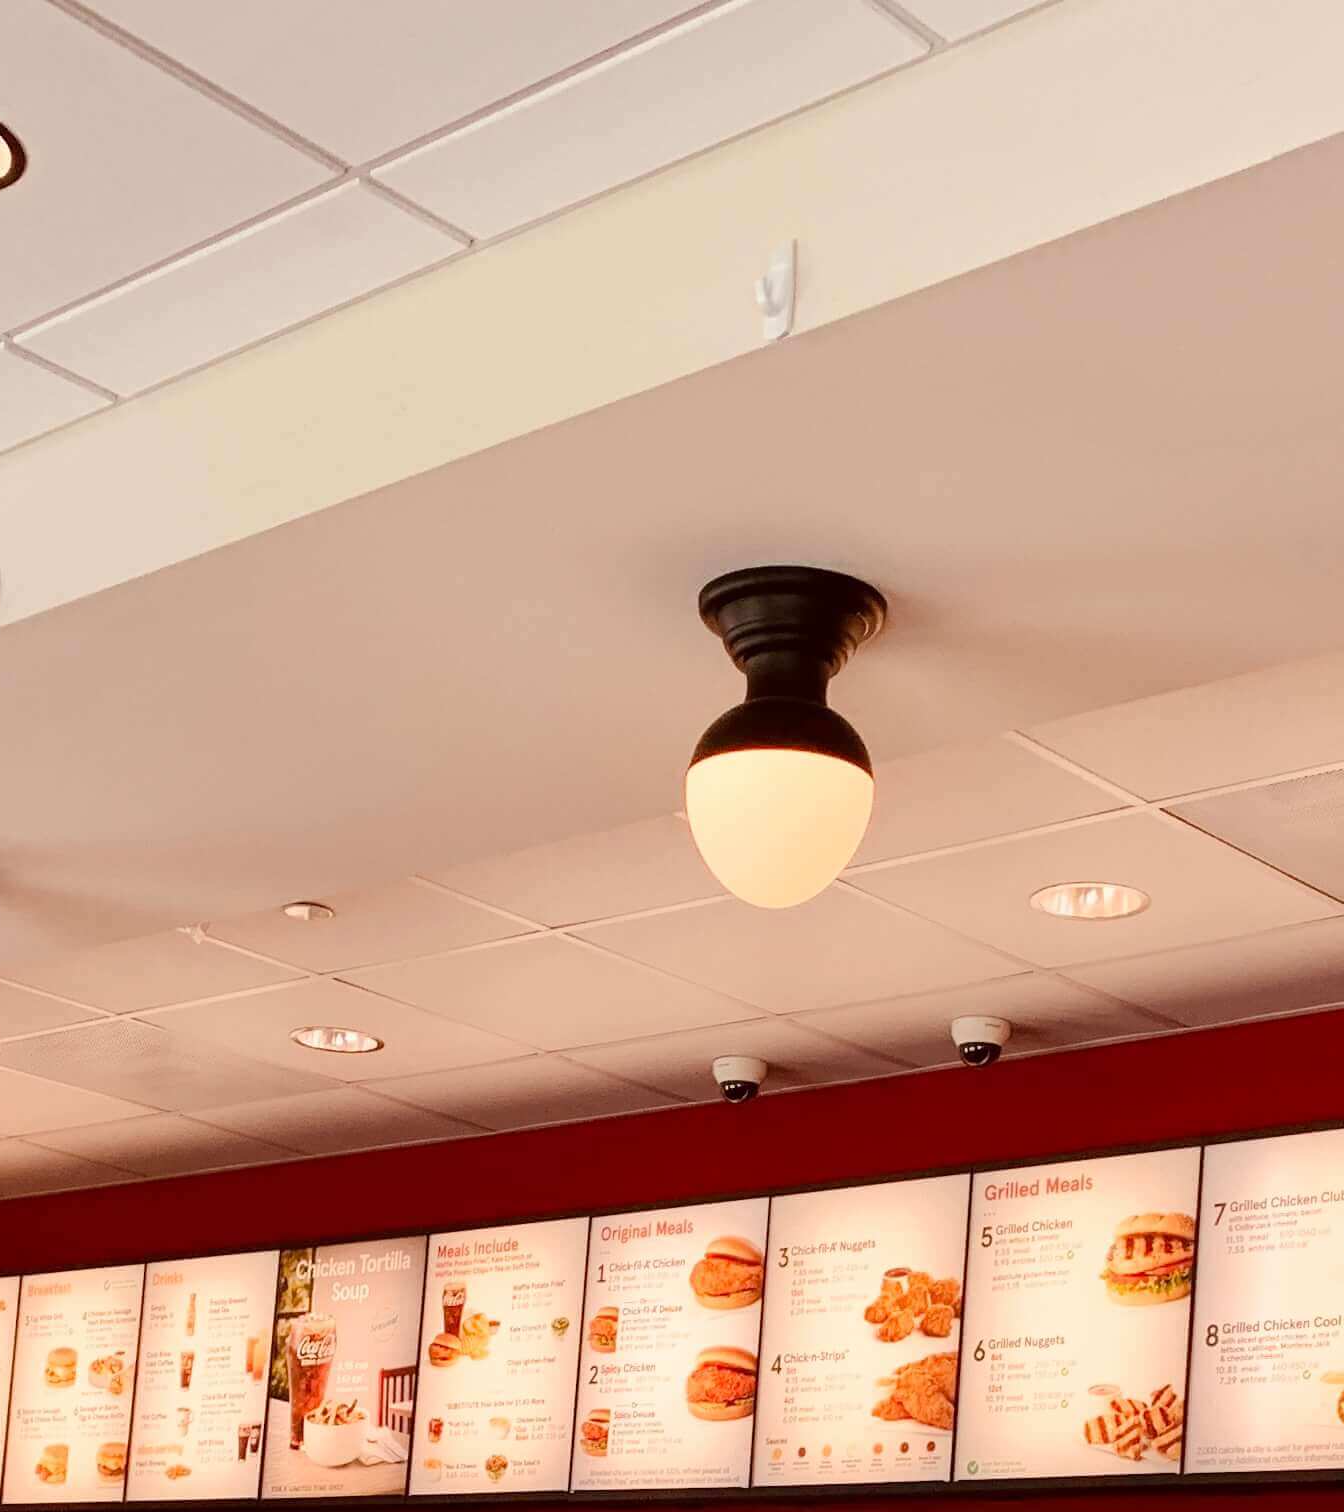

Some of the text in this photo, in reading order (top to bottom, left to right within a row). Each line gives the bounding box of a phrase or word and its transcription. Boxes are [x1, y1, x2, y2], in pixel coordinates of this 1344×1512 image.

[985, 1174, 1093, 1200] Grilled Meals
[1214, 1203, 1226, 1226] 7
[1230, 1201, 1267, 1213] Grilled
[1271, 1195, 1318, 1208] Chicken
[601, 1220, 693, 1244] Original Meals
[981, 1219, 1072, 1248] 5 Grilled Chicken
[437, 1238, 518, 1258] Meals Include
[778, 1248, 788, 1268] 3
[840, 1238, 876, 1252] Nuggets
[296, 1257, 356, 1280] Chicken
[360, 1250, 410, 1274] Tortilla
[597, 1264, 606, 1283] 1
[652, 1258, 686, 1269] Chicken
[331, 1281, 369, 1302] Soup
[1207, 1325, 1218, 1346] 8
[1222, 1323, 1260, 1335] Grilled
[1264, 1319, 1310, 1330] Chicken
[1314, 1316, 1342, 1328] Cool
[974, 1335, 1065, 1361] 6 Grilled Nuggets
[589, 1365, 598, 1385] 2
[601, 1365, 621, 1376] Spicy
[624, 1363, 656, 1373] Chicken
[771, 1354, 782, 1375] 4
